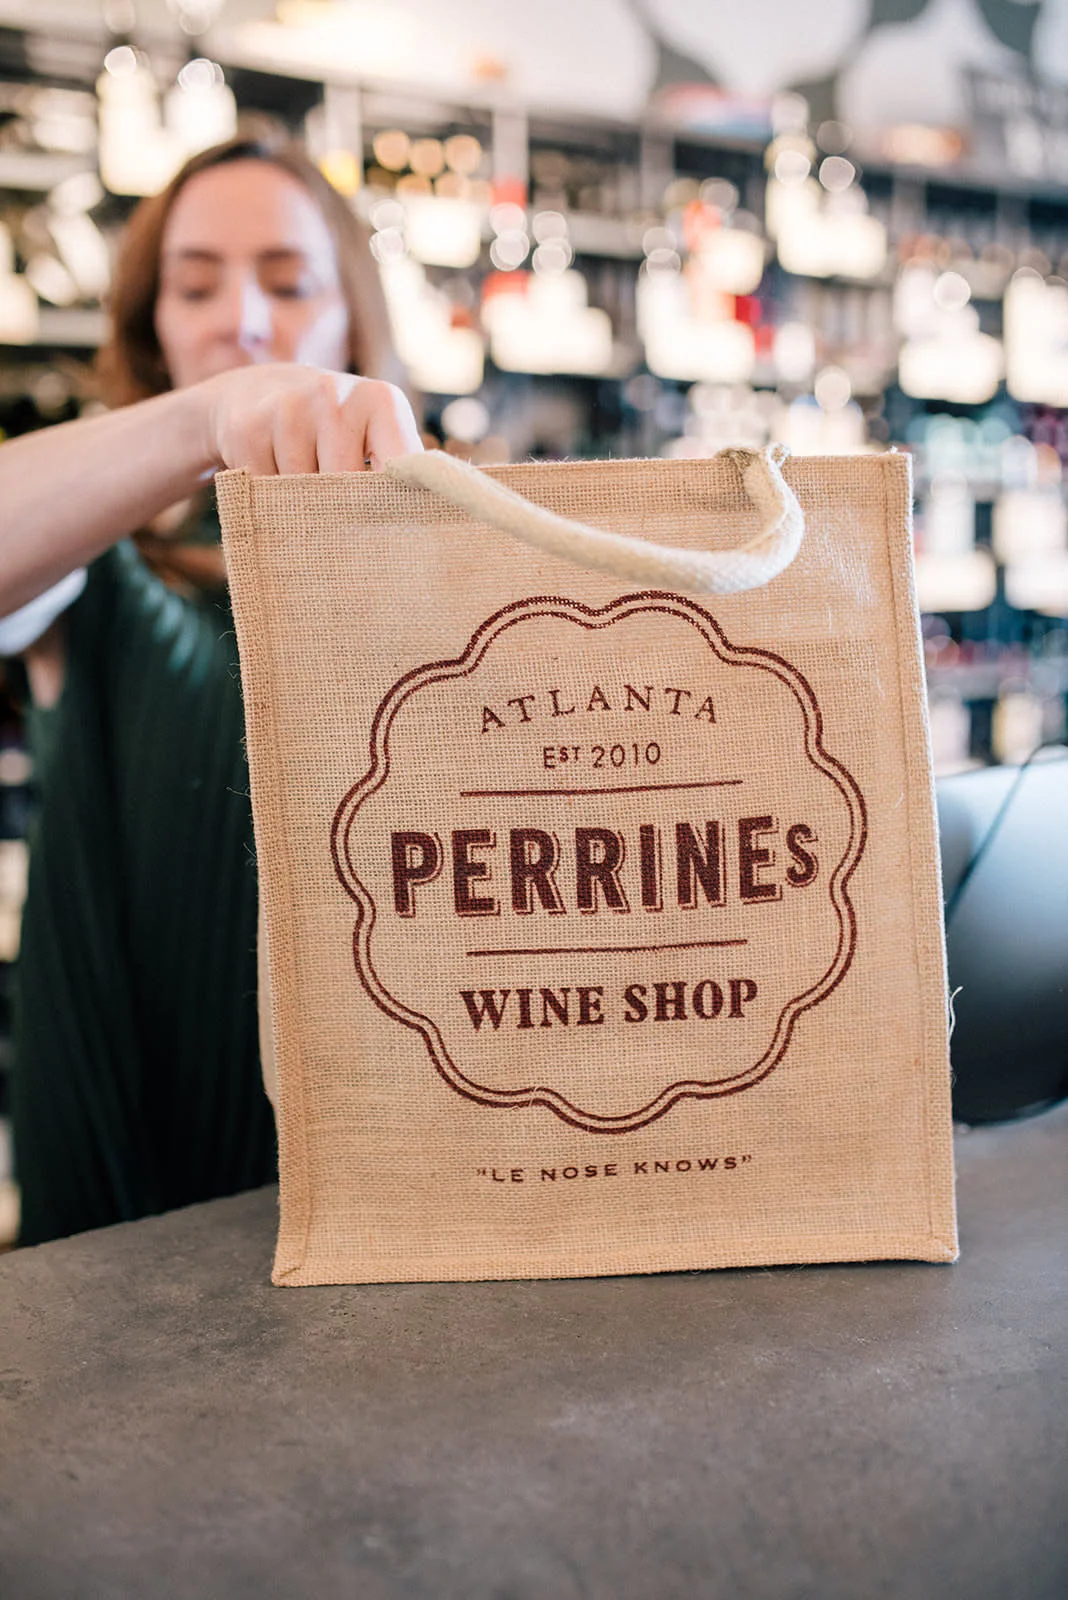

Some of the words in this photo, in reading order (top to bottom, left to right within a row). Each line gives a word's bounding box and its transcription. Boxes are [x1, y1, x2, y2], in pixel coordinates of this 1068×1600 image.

[481, 684, 717, 734] ATLANTA
[542, 746, 581, 770] EST
[591, 741, 662, 769] 2010
[459, 985, 605, 1033] WINE
[623, 978, 758, 1024] SHOP
[540, 1163, 618, 1182] NOSE
